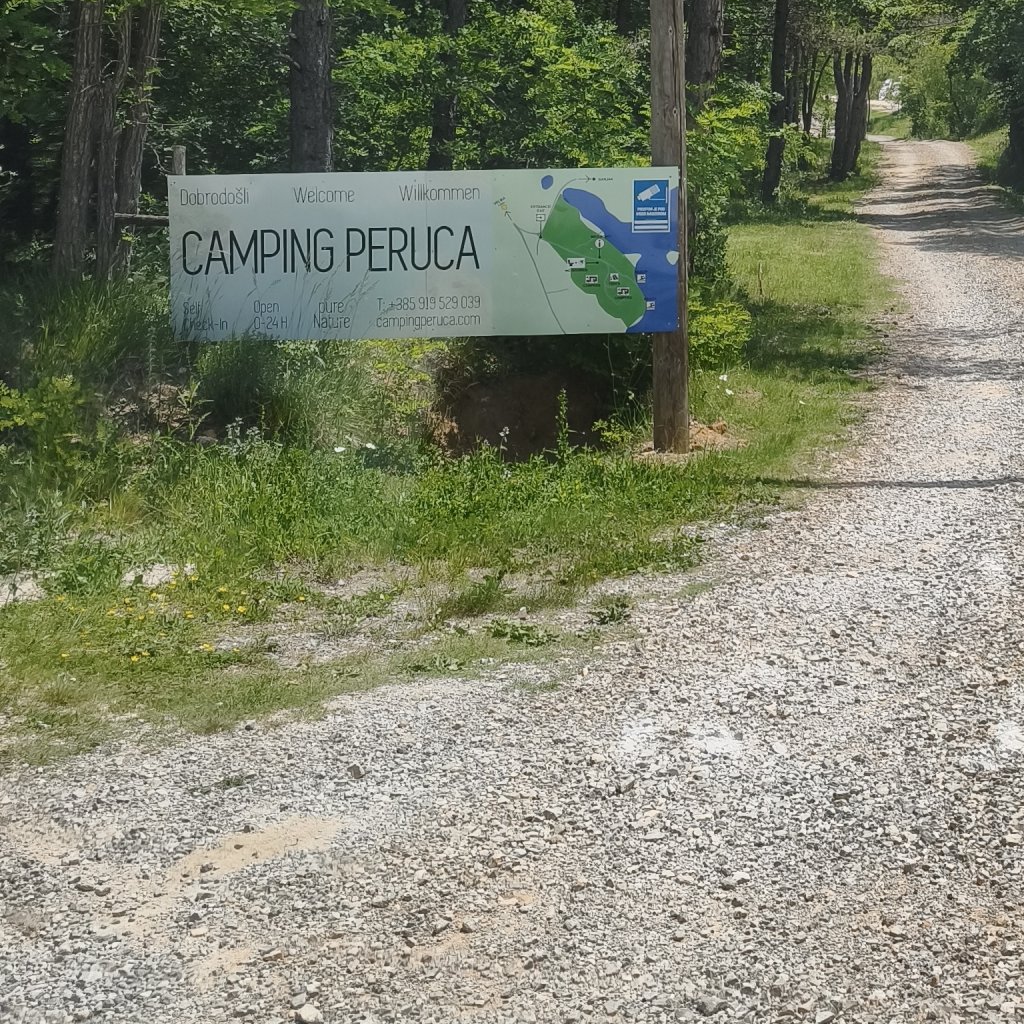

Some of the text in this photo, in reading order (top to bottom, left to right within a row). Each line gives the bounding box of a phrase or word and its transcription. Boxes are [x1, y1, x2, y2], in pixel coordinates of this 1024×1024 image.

[180, 187, 250, 206] Dobrodošli
[293, 185, 355, 204] Welcome
[399, 184, 481, 201] Willkommen
[182, 225, 480, 275] CAMPING PERUCA
[253, 300, 280, 317] Open
[318, 301, 344, 317] pure
[388, 297, 416, 311] +385
[418, 296, 436, 310] 919
[438, 296, 458, 309] 529
[461, 295, 481, 309] 039
[313, 313, 350, 329] Nature
[376, 314, 481, 330] campingperuca.com
